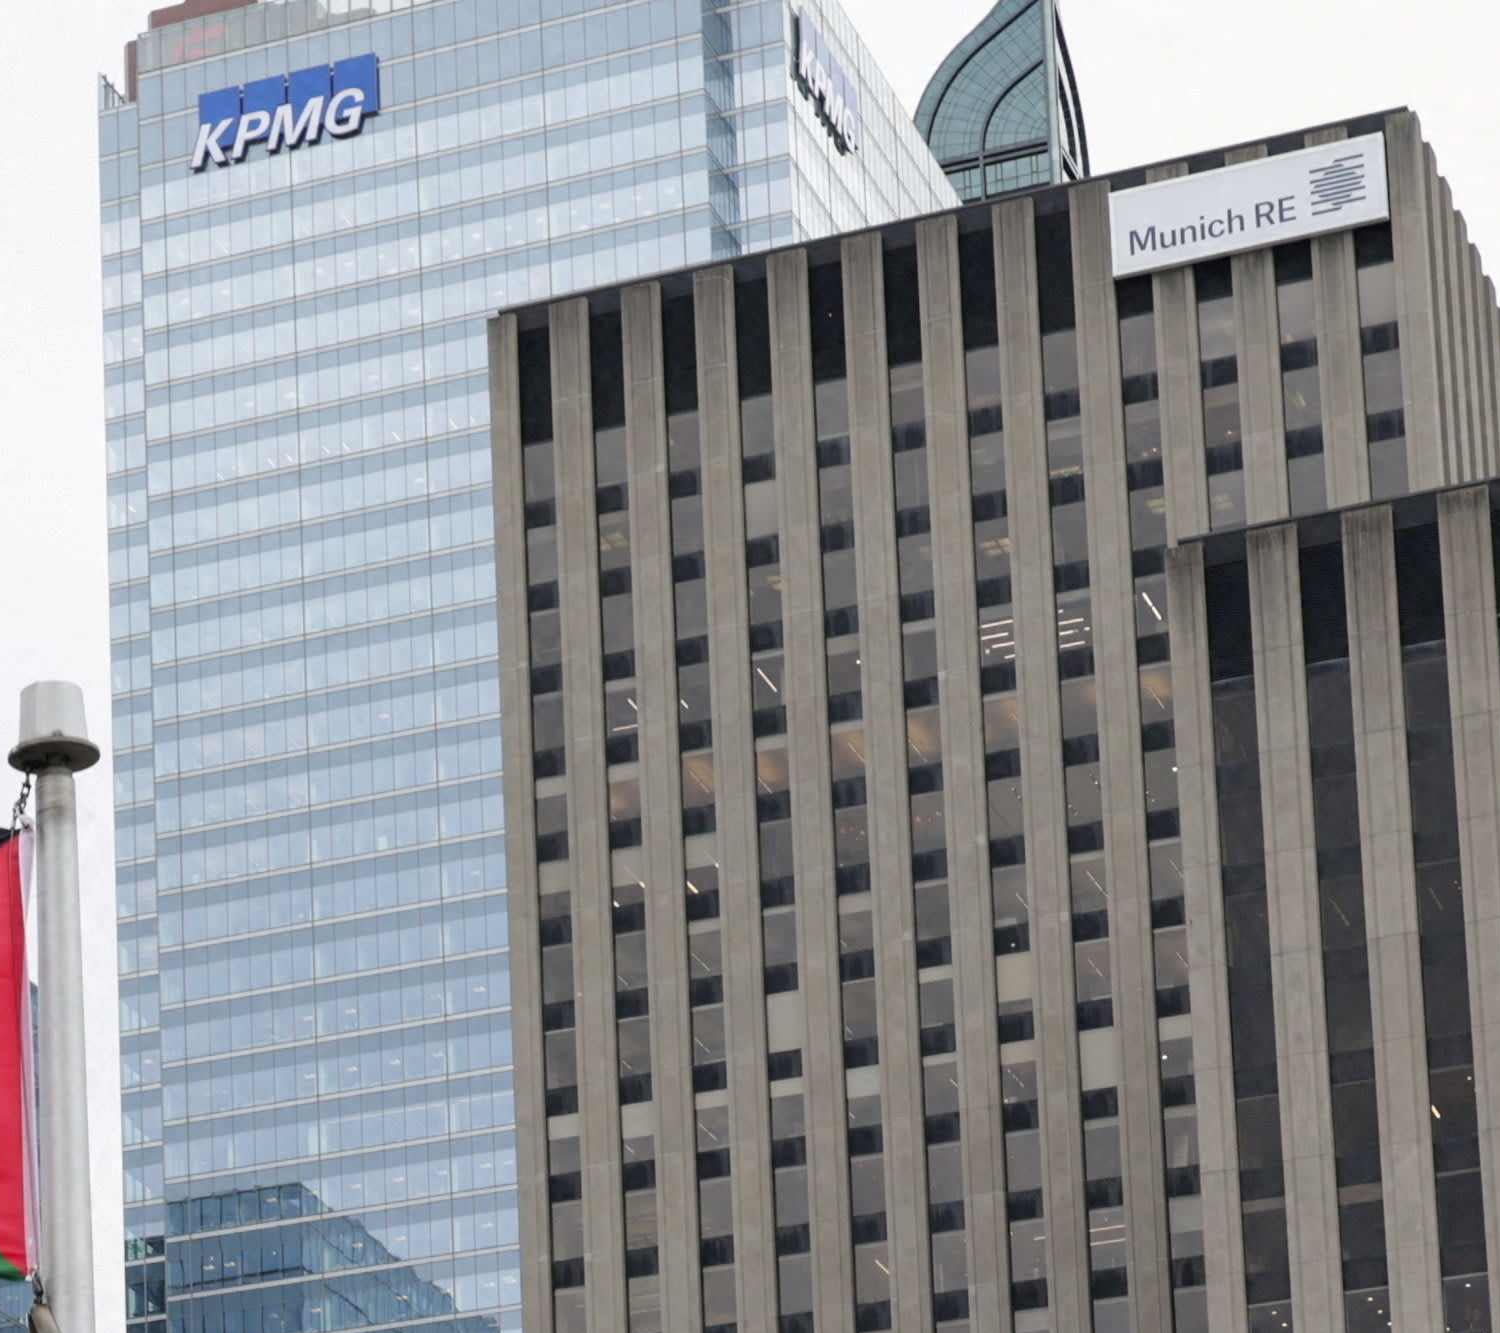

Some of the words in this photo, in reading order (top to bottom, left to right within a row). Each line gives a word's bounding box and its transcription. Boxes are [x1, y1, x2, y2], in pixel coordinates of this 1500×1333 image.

[190, 88, 365, 169] KPMG
[799, 40, 856, 154] KPMG
[1129, 208, 1245, 256] Munich
[1254, 195, 1297, 228] RE
